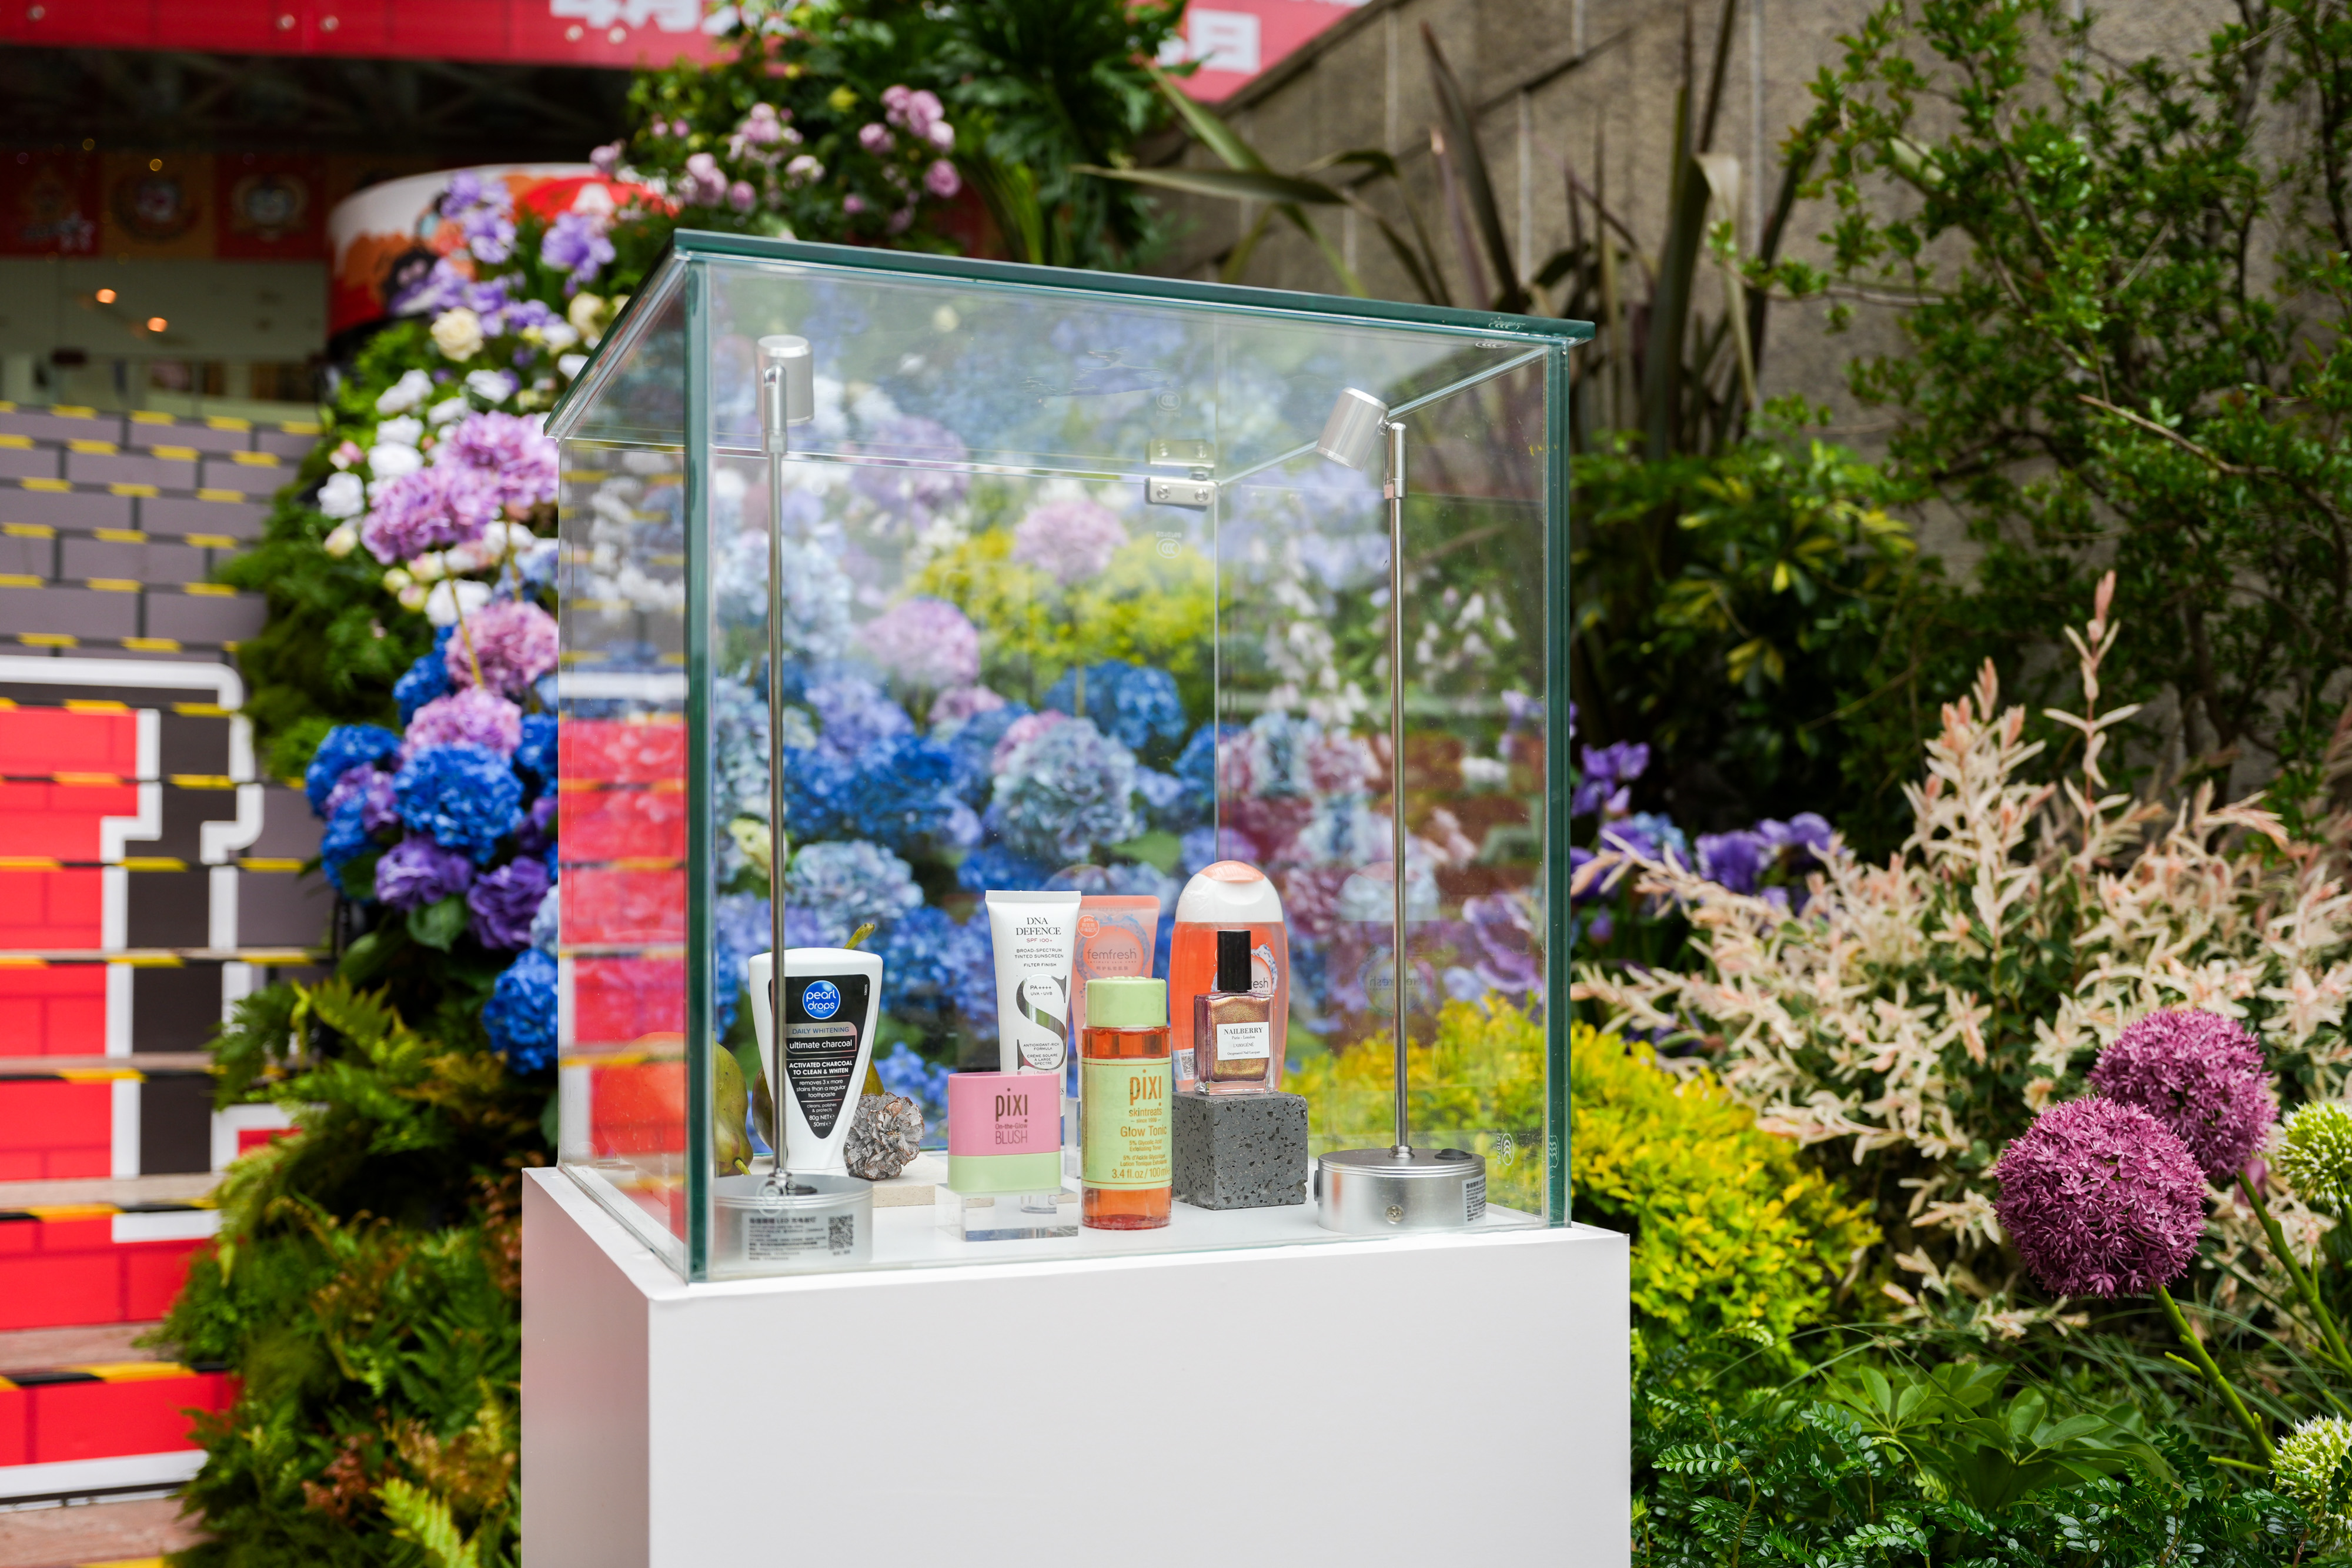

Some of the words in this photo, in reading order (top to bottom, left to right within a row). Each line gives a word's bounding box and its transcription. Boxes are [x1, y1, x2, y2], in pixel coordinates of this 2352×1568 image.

[1016, 927, 1061, 935] DEFENCE
[1087, 948, 1137, 959] femfresh
[806, 989, 836, 1002] pearl
[808, 1001, 835, 1011] drops
[822, 1039, 853, 1048] charcoal
[1129, 1108, 1162, 1117] skintreats
[1120, 1126, 1145, 1137] Glow
[1148, 1125, 1167, 1136] Tonic
[995, 1130, 1028, 1145] BLUSH
[1112, 1168, 1125, 1179] 3.4
